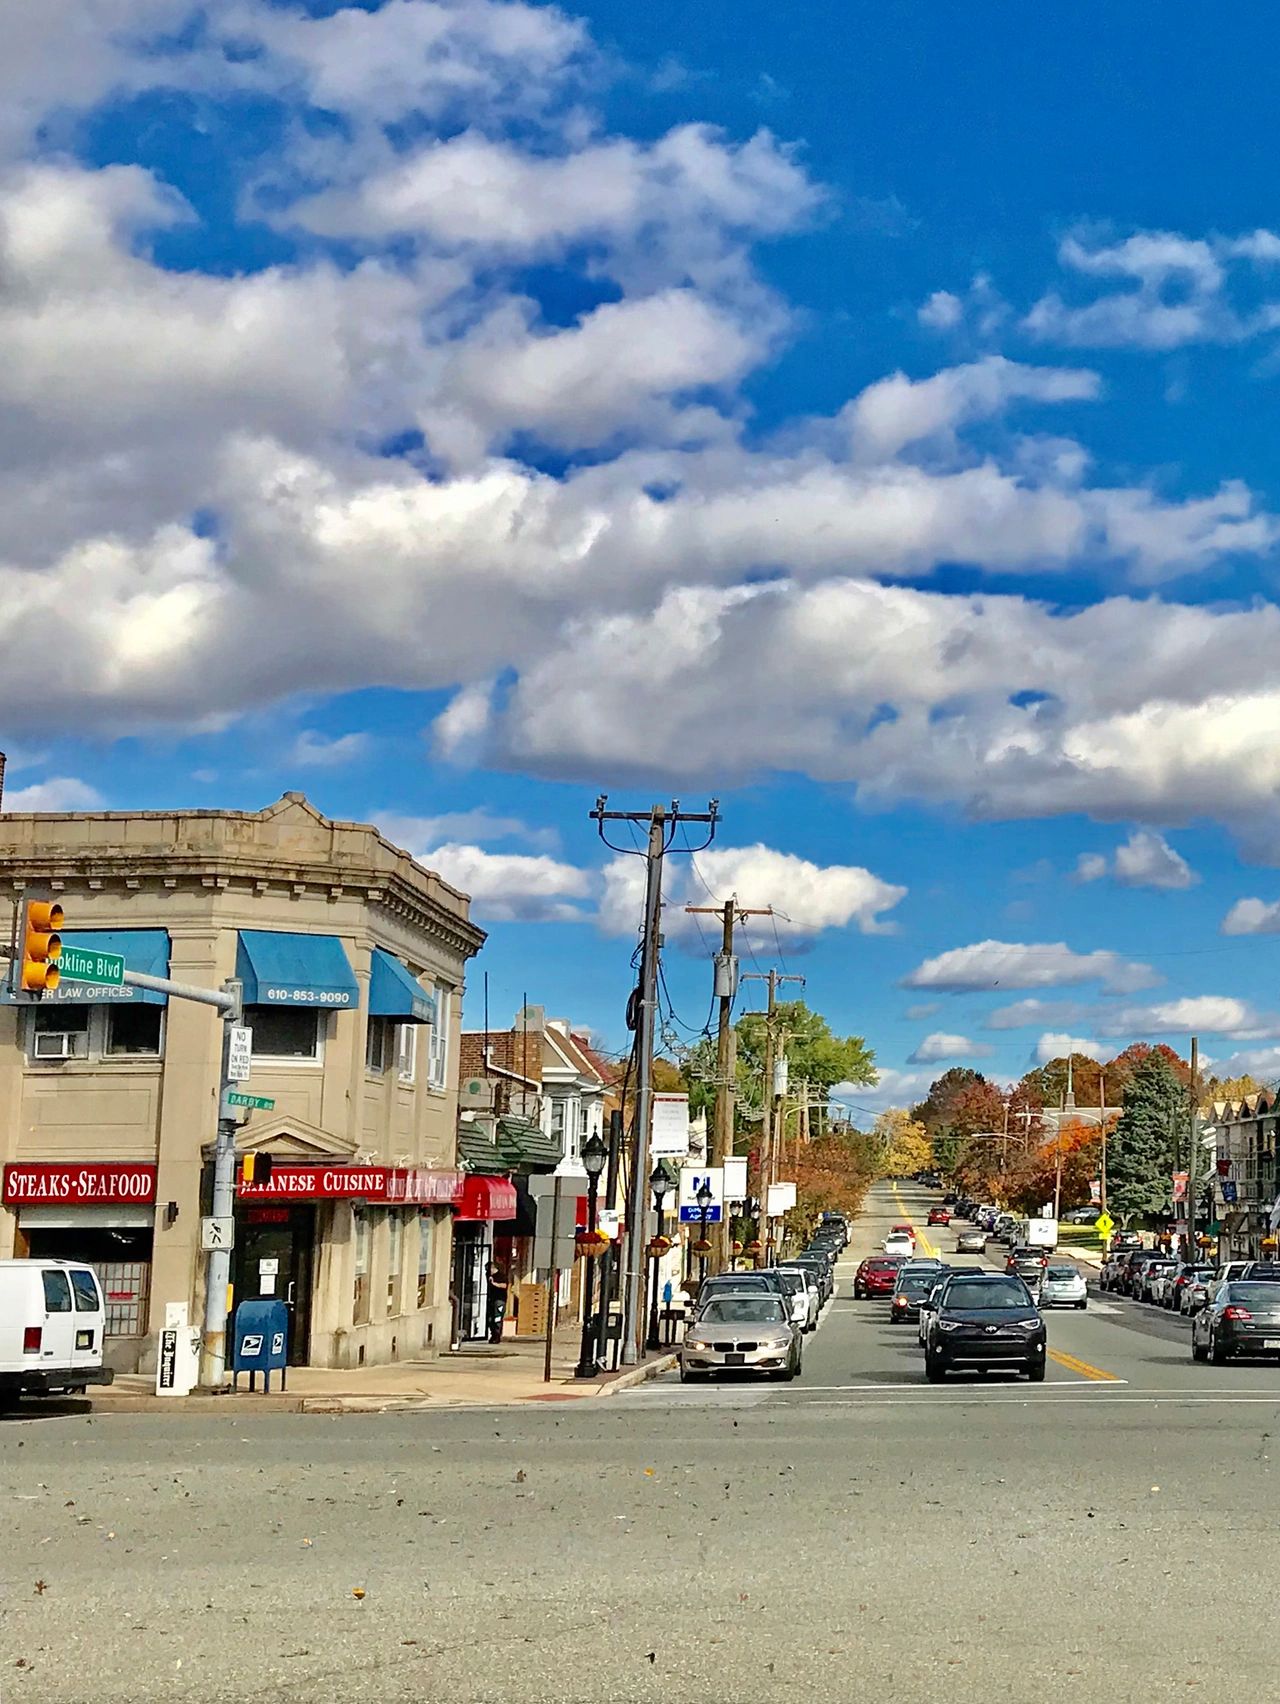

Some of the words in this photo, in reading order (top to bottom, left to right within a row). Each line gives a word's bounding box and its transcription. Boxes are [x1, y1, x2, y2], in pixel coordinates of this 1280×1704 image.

[96, 957, 120, 978] Blvd
[58, 987, 82, 999] LAW
[86, 986, 134, 998] OFFICES
[267, 989, 350, 1003] 610-853-9090
[236, 1031, 246, 1042] NO
[230, 1094, 260, 1108] DARBY
[323, 1172, 384, 1191] CUISINE
[164, 1331, 176, 1350] The
[161, 1350, 174, 1387] Inquirer
